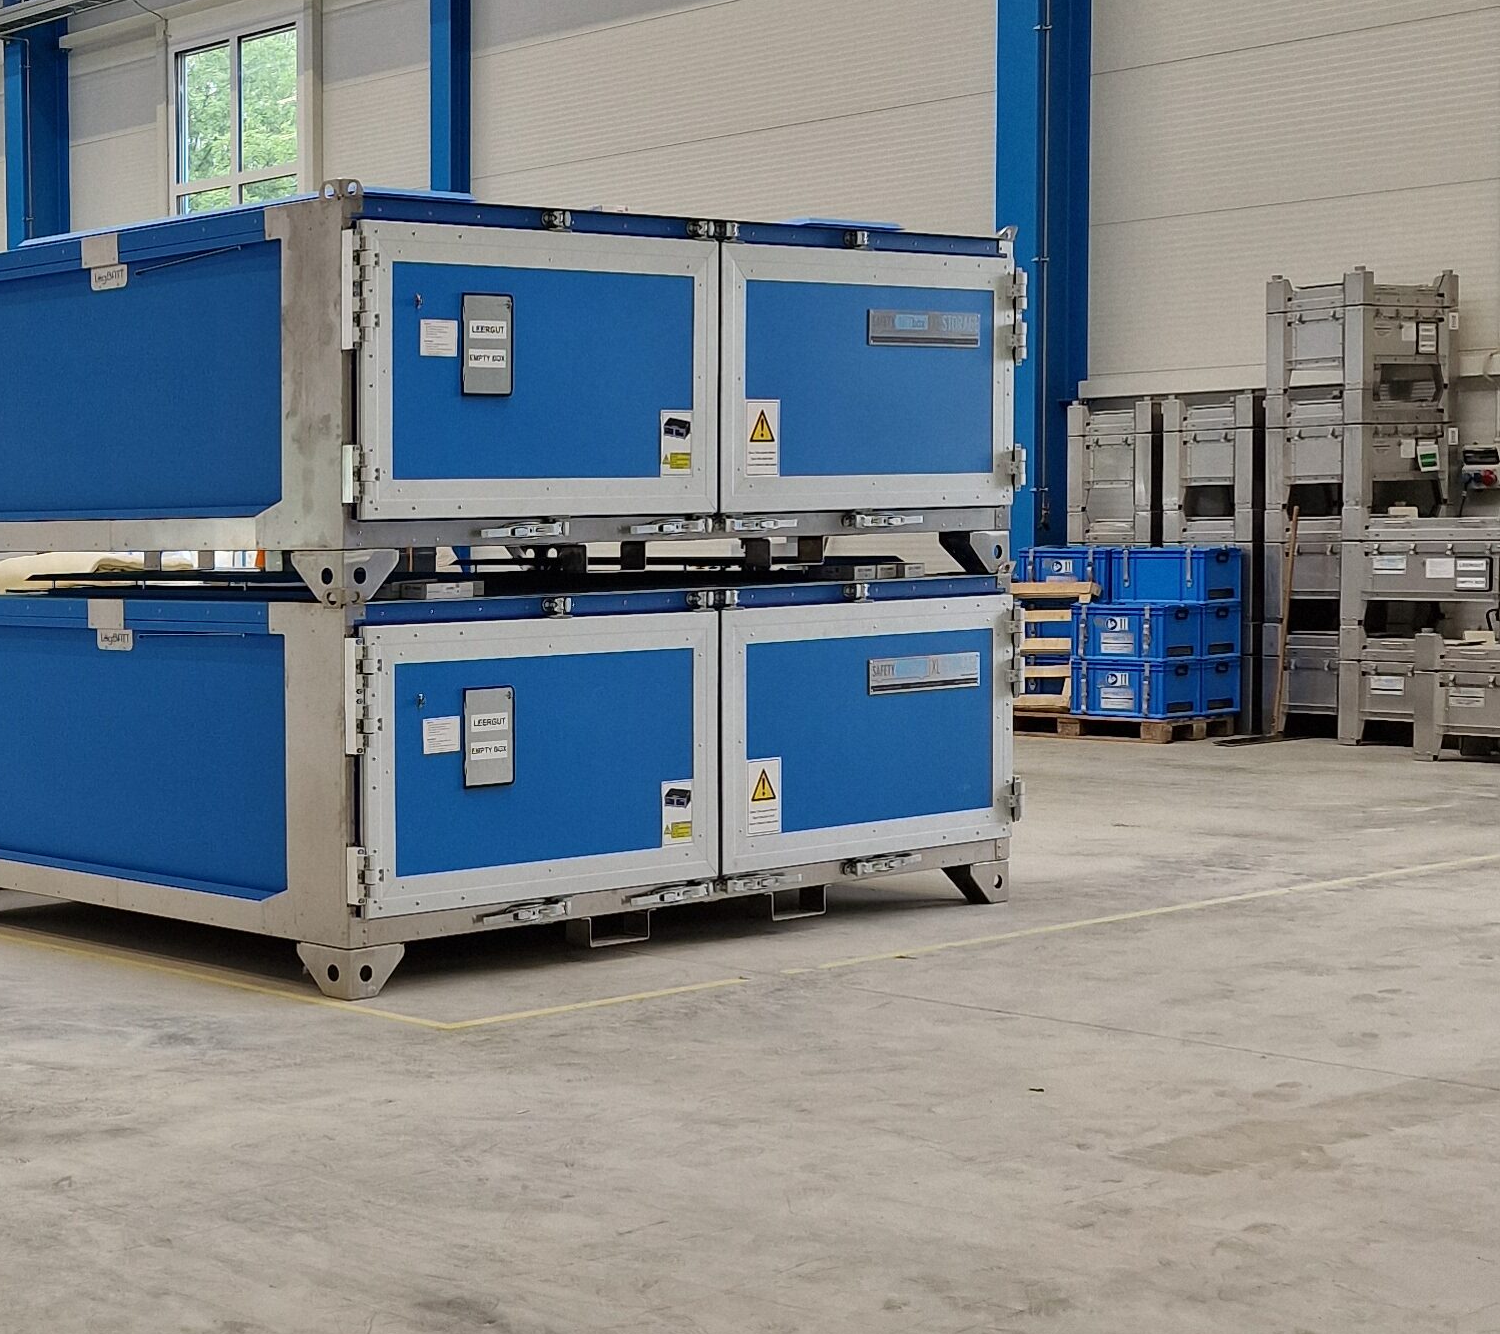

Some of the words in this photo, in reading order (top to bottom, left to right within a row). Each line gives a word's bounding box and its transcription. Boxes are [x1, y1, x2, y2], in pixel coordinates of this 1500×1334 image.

[471, 325, 504, 334] LEERGUT
[469, 354, 490, 362] EMPTY
[473, 717, 506, 727] LEERGUT
